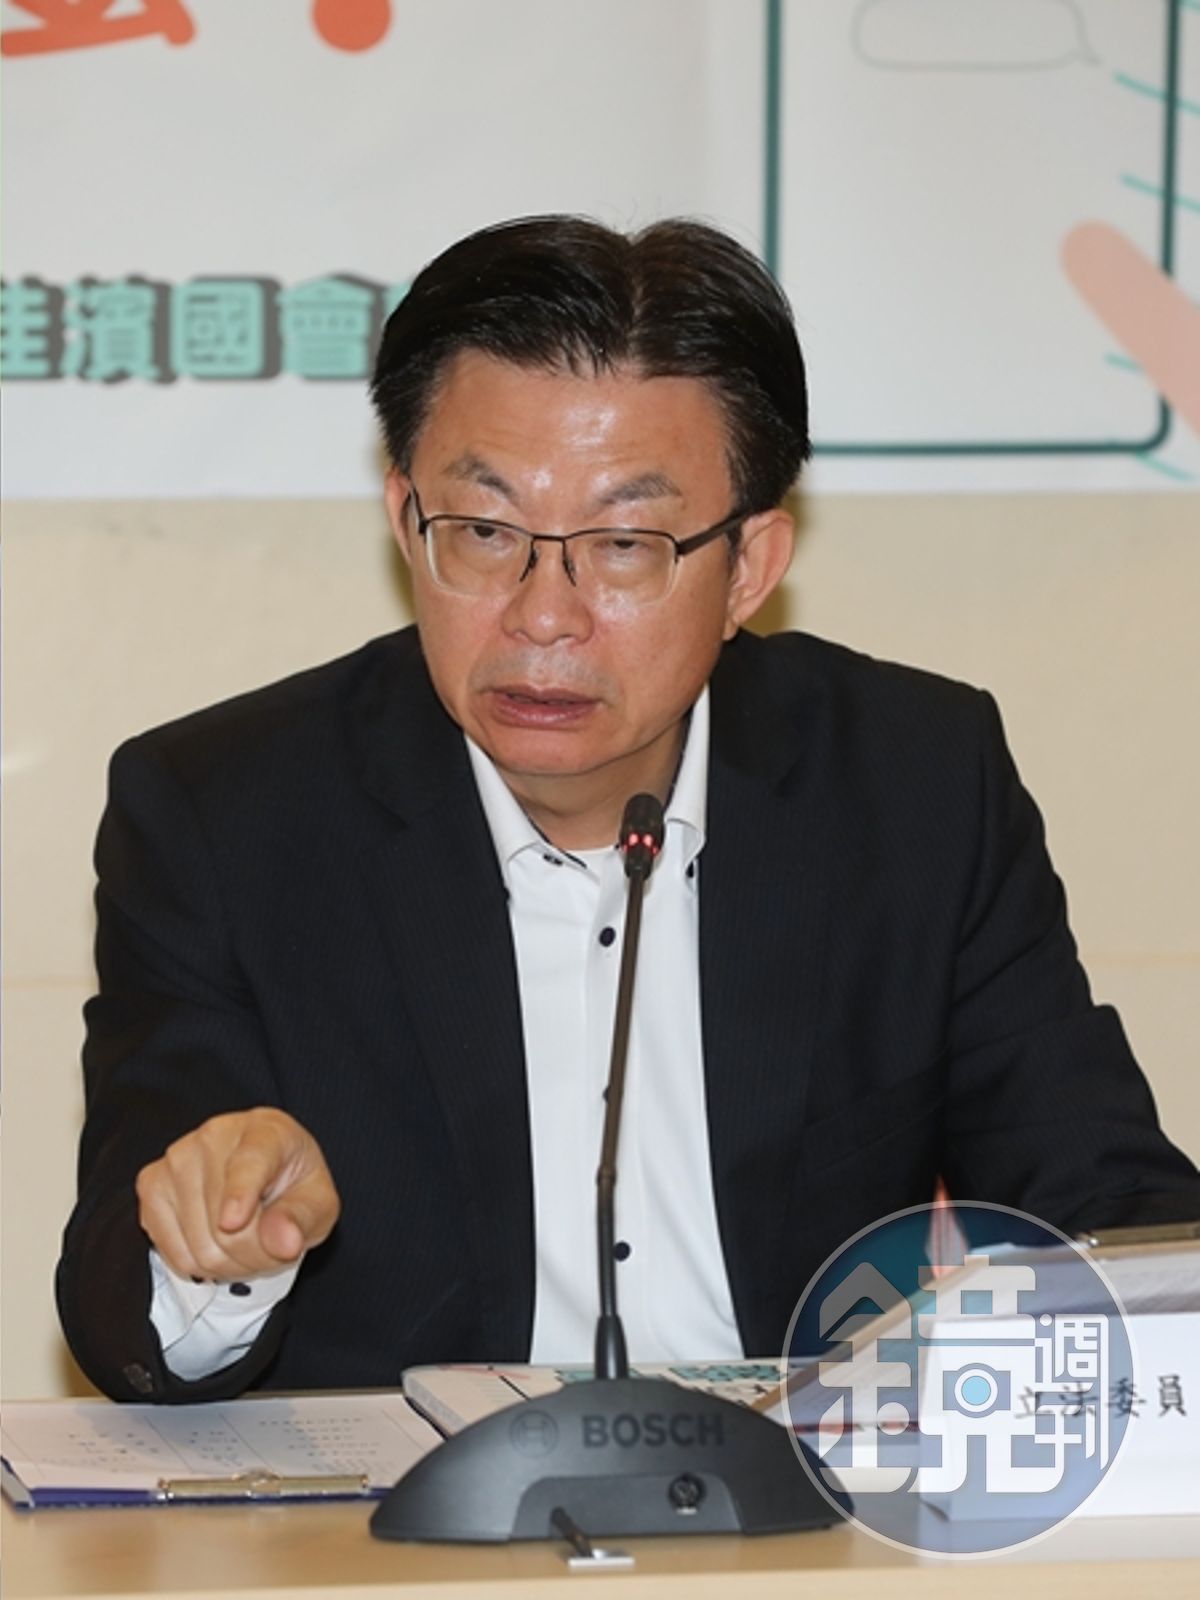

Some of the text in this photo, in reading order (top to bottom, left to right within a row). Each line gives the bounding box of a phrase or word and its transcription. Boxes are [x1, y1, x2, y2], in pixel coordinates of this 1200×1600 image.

[0, 275, 412, 383] 濱國會
[581, 1413, 725, 1449] BOSCH
